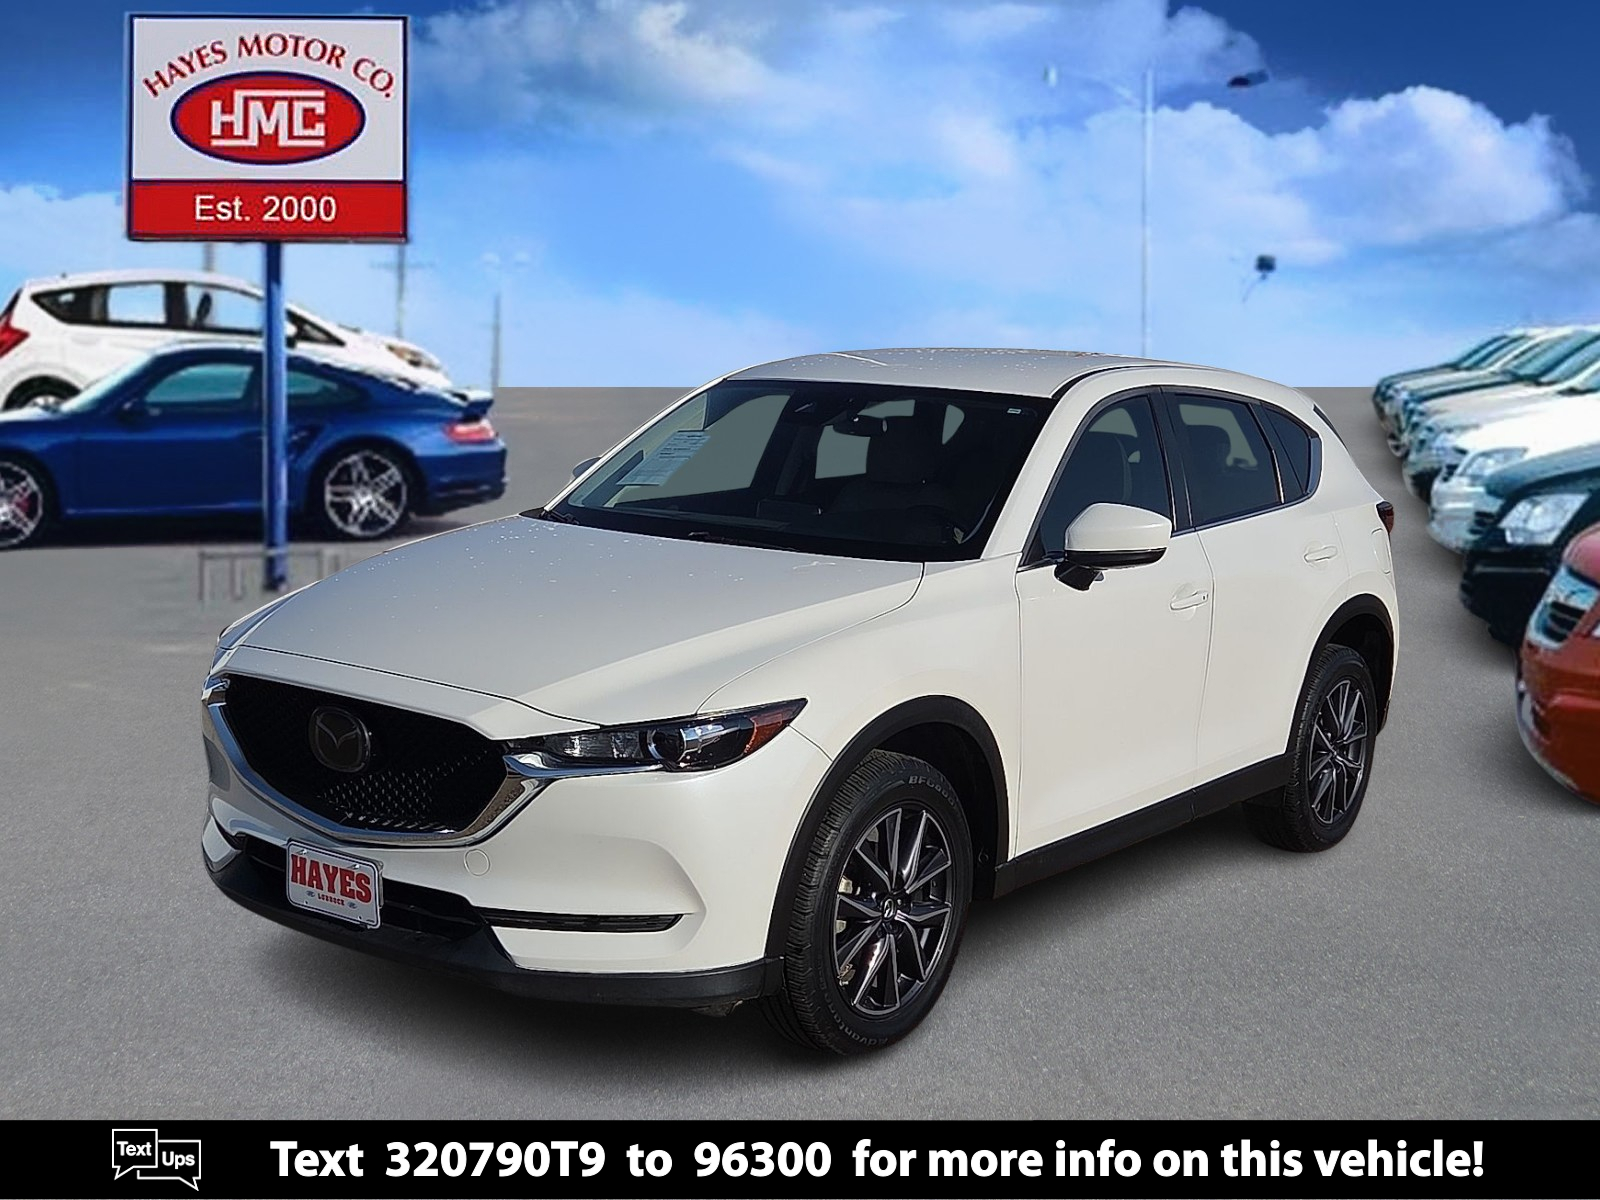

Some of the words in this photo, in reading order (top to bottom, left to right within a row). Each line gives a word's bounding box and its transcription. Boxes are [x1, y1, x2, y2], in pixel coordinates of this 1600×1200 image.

[143, 40, 228, 98] HAYES
[237, 32, 347, 70] MOTOR
[353, 57, 395, 98] CO.
[210, 88, 326, 147] HMC
[194, 194, 251, 222] Est.
[262, 195, 337, 222] 2000
[290, 853, 372, 904] HAYES
